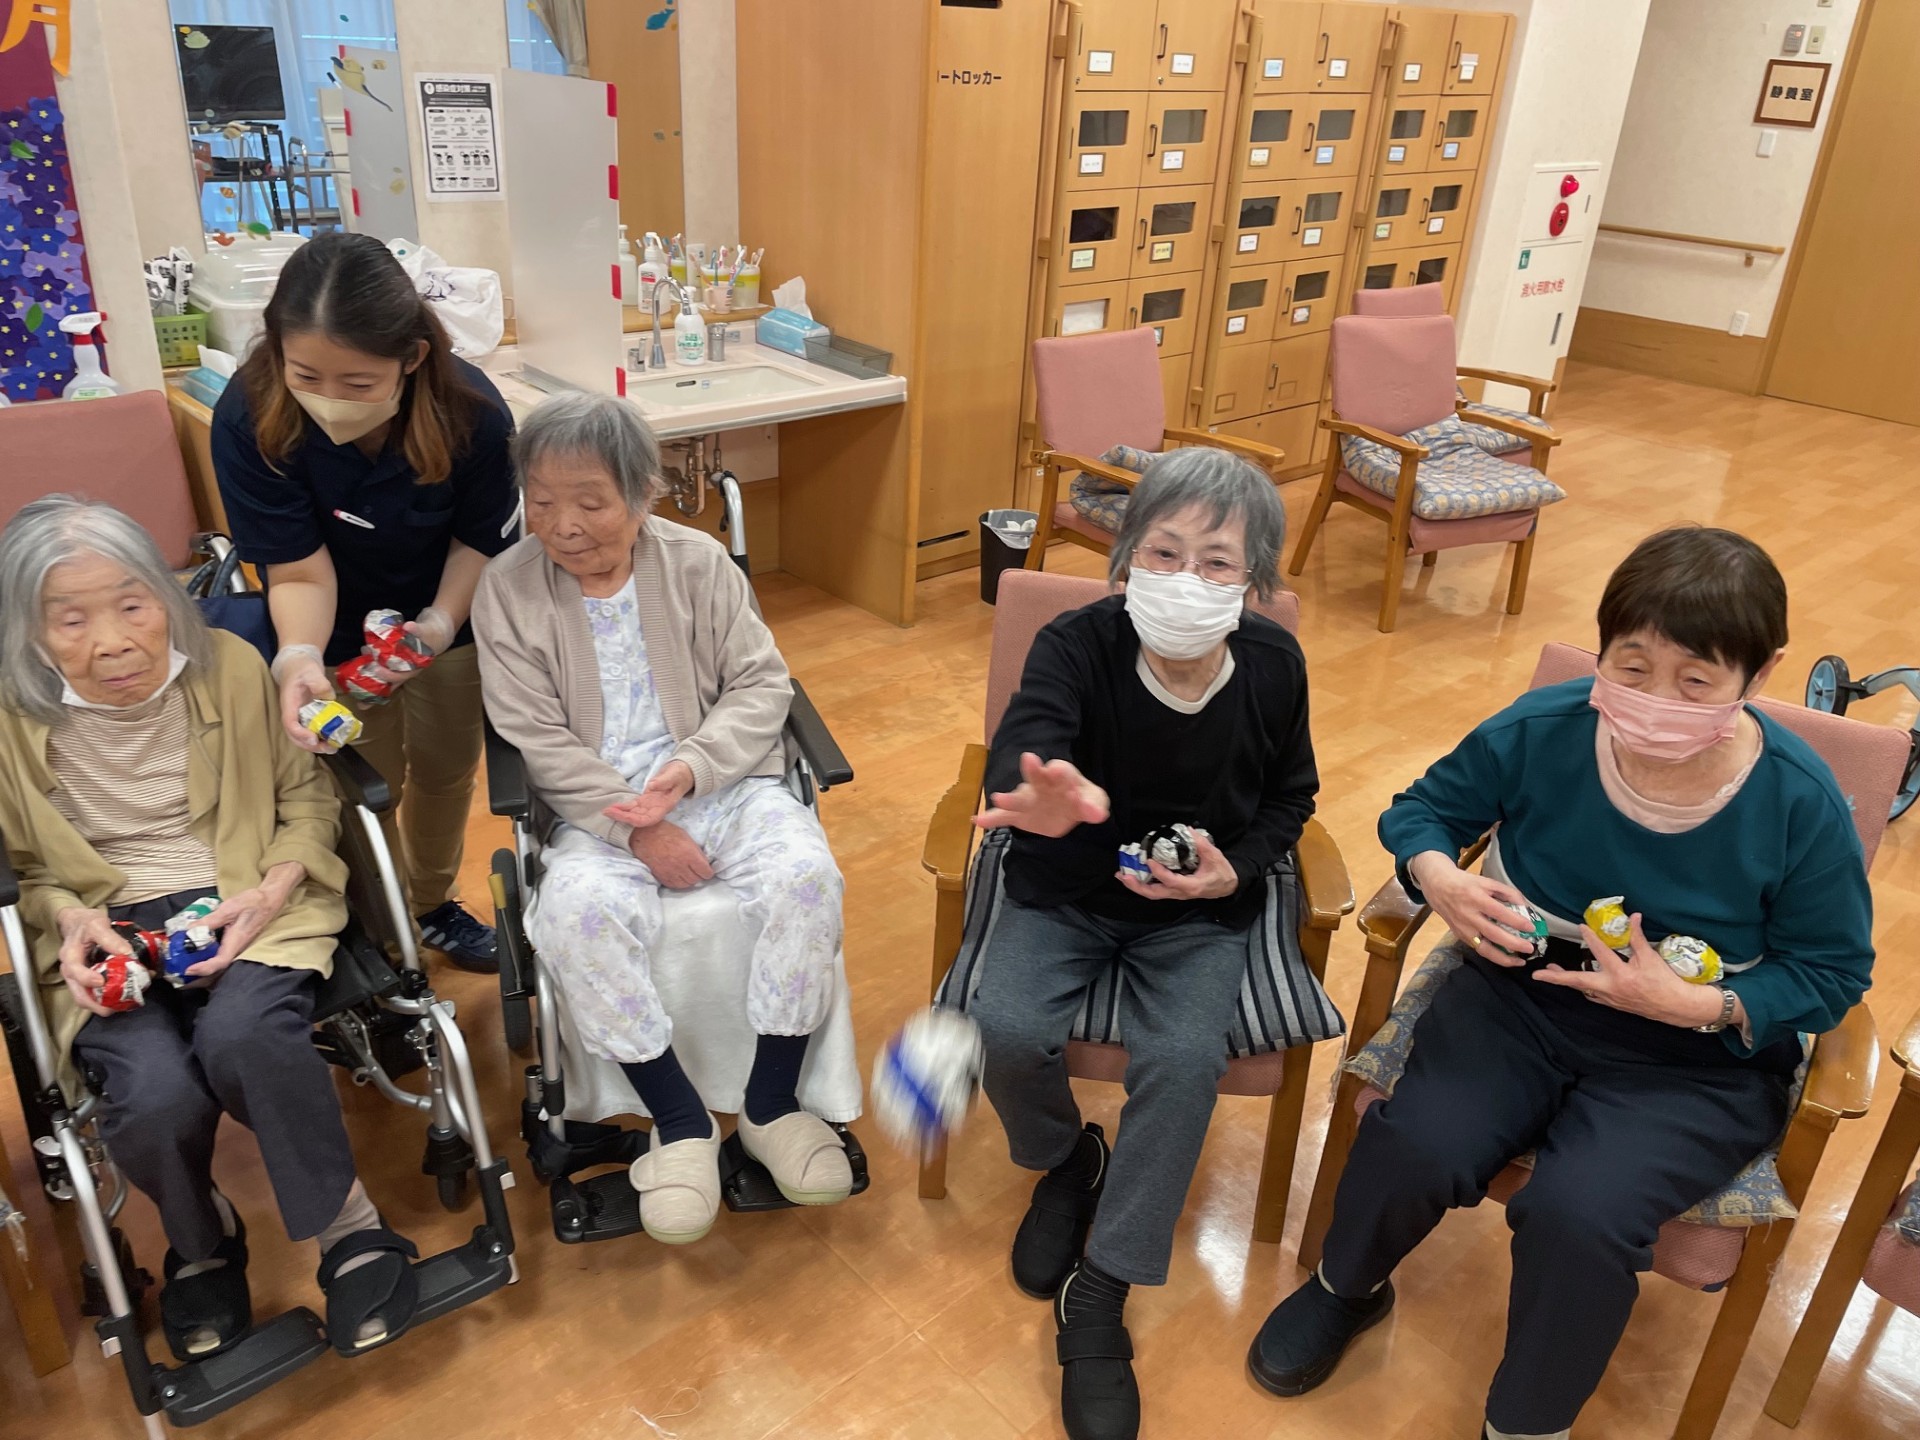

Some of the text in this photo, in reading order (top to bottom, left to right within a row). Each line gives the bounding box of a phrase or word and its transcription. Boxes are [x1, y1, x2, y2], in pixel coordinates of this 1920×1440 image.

[937, 69, 1002, 85] ートロッカー
[1770, 85, 1814, 102] 静養室
